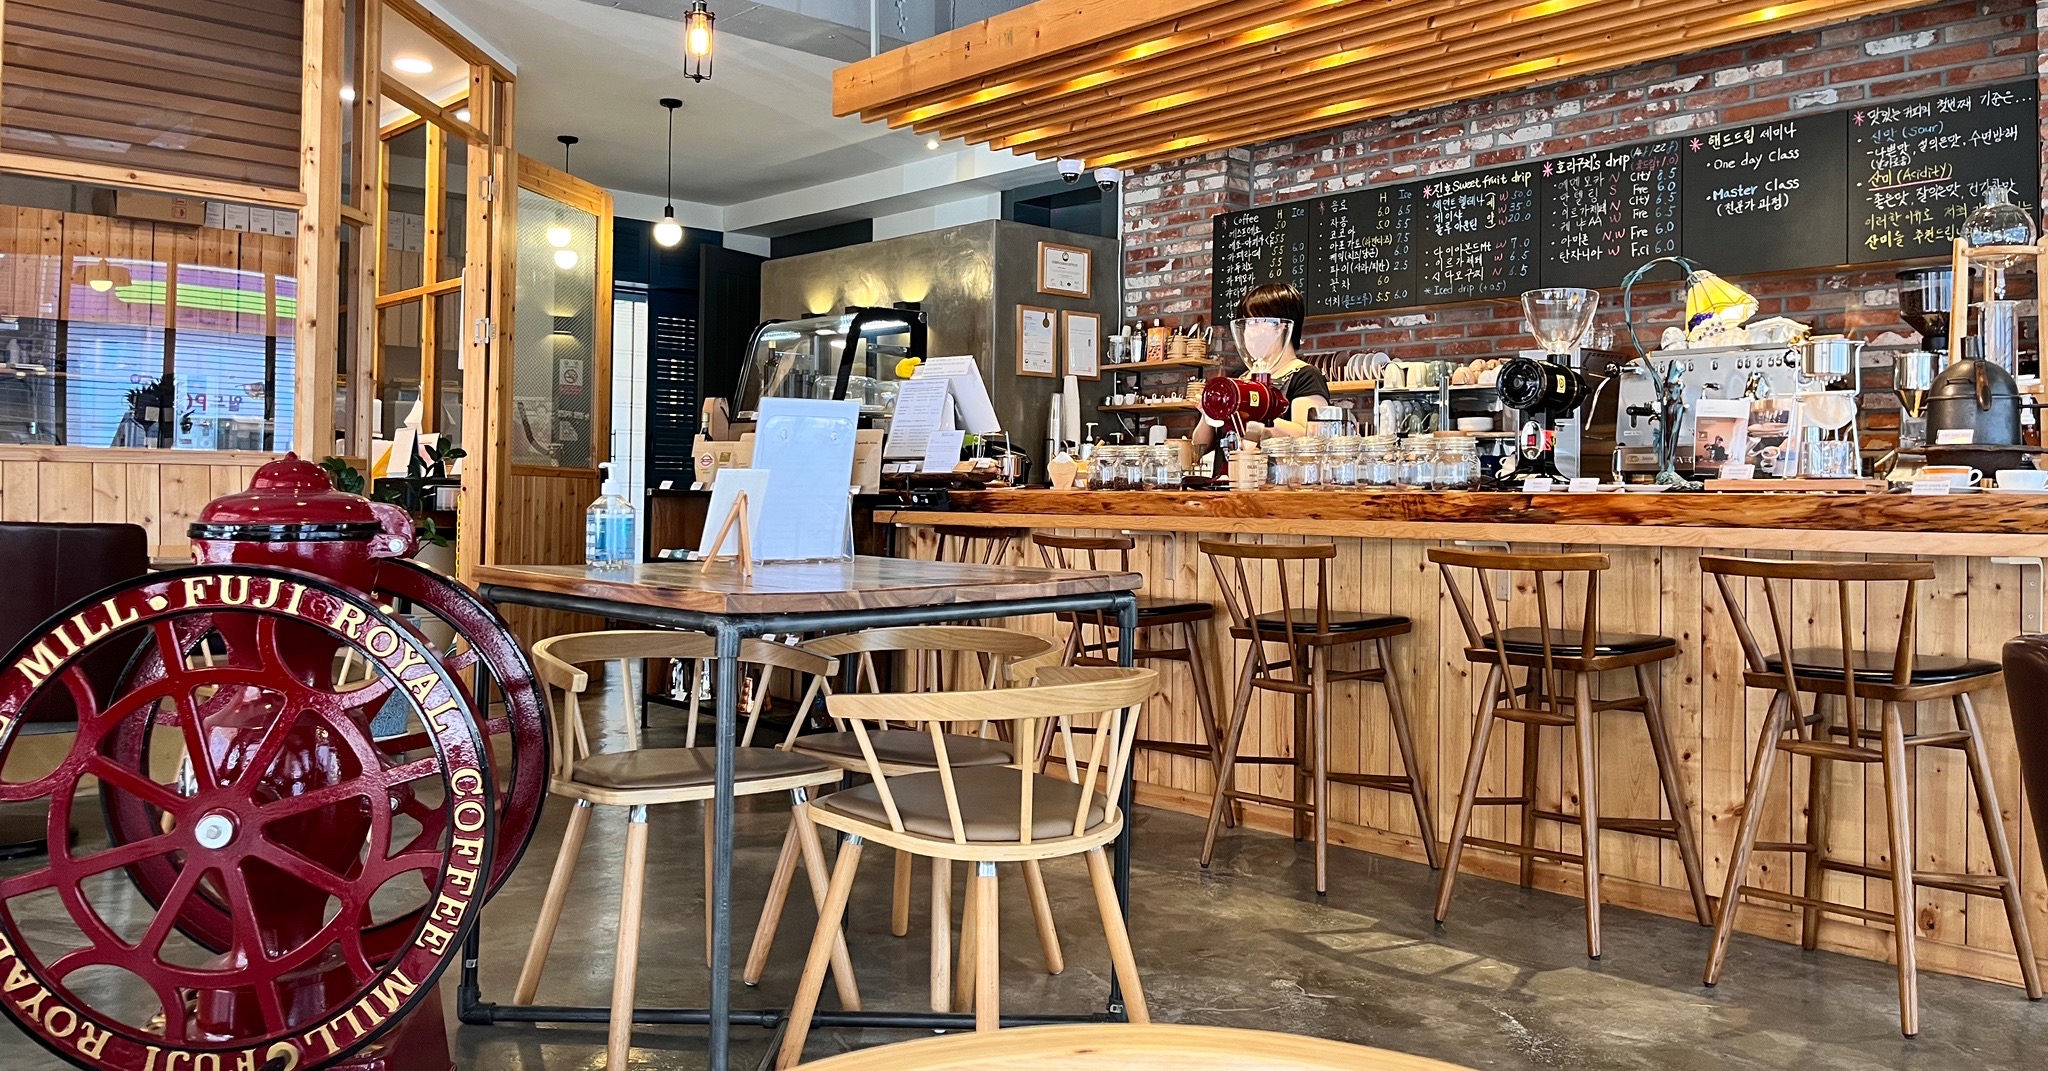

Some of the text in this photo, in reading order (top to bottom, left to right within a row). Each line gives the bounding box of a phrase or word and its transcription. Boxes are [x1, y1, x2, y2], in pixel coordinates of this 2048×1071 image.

[1867, 106, 1901, 126] 맛있는
[1903, 102, 1931, 118] 커피의
[1708, 122, 1797, 150] 핸드드립 세미나
[1605, 152, 1630, 171] drip
[1714, 160, 1736, 169] One
[1740, 152, 1762, 170] day
[1482, 174, 1507, 188] fruit
[1511, 170, 1531, 187] drip
[1609, 172, 1620, 182] N
[1896, 163, 1953, 185] (Acidity)
[1380, 192, 1387, 203] H
[1399, 189, 1412, 200] Ice
[1610, 185, 1616, 195] S
[1633, 184, 1648, 195] Fre
[1713, 184, 1758, 200] Master
[1610, 200, 1621, 211] N
[1656, 192, 1677, 204] 6.5
[1234, 208, 1305, 225] Coffee H Ice
[1330, 204, 1411, 228] 자몽 6.0 6.5
[1508, 213, 1531, 222] 20.0
[1610, 212, 1621, 223] W
[1633, 209, 1648, 219] Fre
[1656, 206, 1676, 217] 6.5
[1396, 218, 1411, 229] 5.5
[1630, 226, 1648, 240] Fre
[1656, 221, 1674, 235] 6.0
[1292, 242, 1305, 252] 6.0
[1394, 244, 1409, 256] 6.0
[1510, 237, 1530, 249] 7.0
[1270, 257, 1283, 267] 5.5
[1292, 254, 1305, 264] 6.0
[1510, 250, 1530, 261] 6.5
[1560, 246, 1603, 264] 탄자니아
[1608, 246, 1620, 256] W
[1655, 240, 1674, 253] 6.0
[1269, 269, 1282, 278] 6.0
[1292, 265, 1304, 275] 6.5
[1393, 260, 1408, 271] 2.5
[1492, 268, 1502, 276] N
[1508, 264, 1528, 276] 6.5
[1394, 289, 1407, 299] 6.0
[1434, 284, 1453, 296] Iced
[1458, 283, 1474, 297] drip
[182, 575, 308, 616] FUJI
[14, 597, 139, 688] MILL
[330, 602, 458, 734] ROYAL
[415, 768, 485, 956] COFFEE
[303, 966, 418, 1054] MILL
